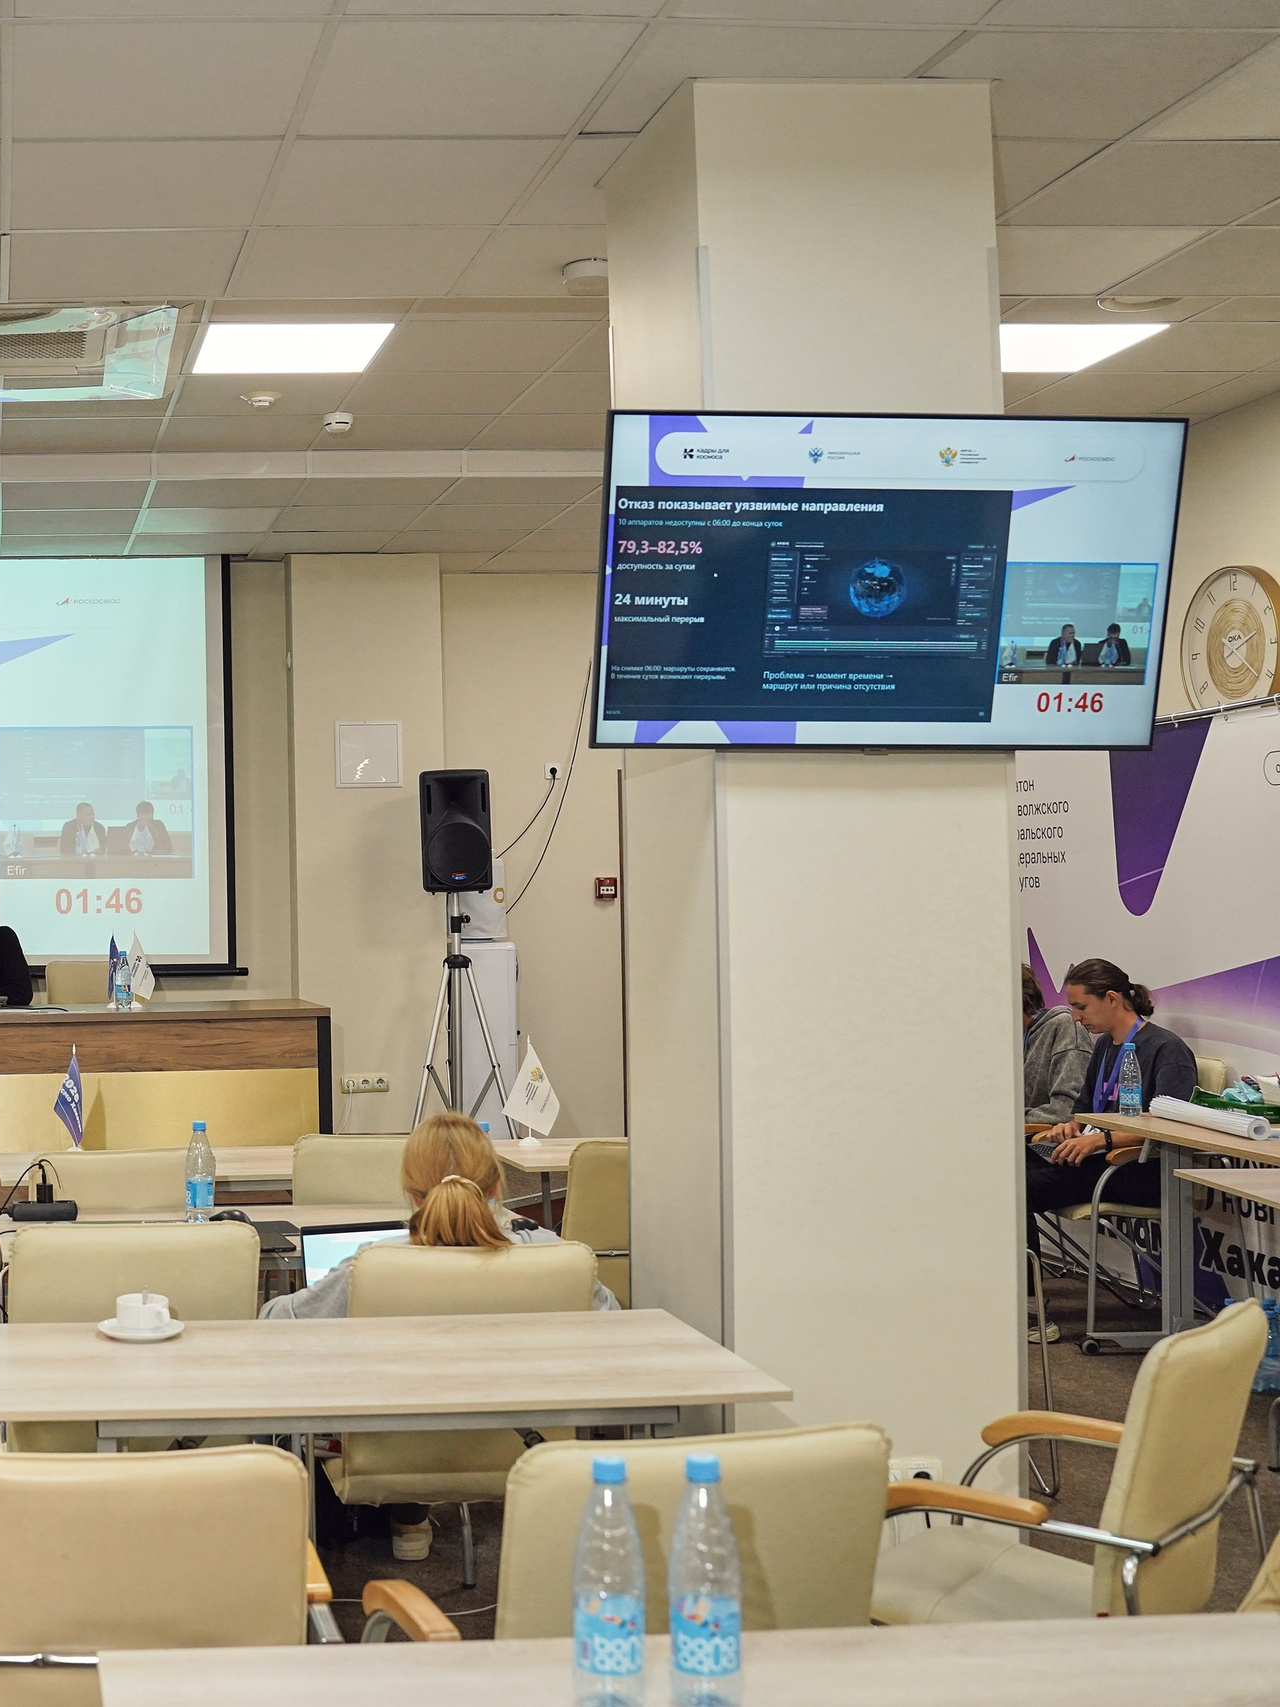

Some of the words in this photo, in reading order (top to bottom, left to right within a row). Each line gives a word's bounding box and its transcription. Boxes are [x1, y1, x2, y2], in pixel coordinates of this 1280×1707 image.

[618, 498, 654, 510] Отказ
[658, 500, 732, 510] показывает
[735, 501, 799, 513] уязвимые
[802, 501, 884, 514] направления
[617, 563, 663, 571] доступность
[1230, 574, 1237, 591] 12
[615, 594, 631, 605] 24
[635, 595, 688, 608] минуты
[614, 615, 669, 623] максимальный
[671, 616, 704, 624] перерыв
[1194, 618, 1205, 633] 10
[1228, 634, 1242, 643] ОКА
[763, 671, 804, 680] Проблема
[848, 673, 883, 681] времени
[1002, 673, 1018, 682] Efir
[762, 682, 798, 691] маршрут
[817, 683, 851, 691] причина
[854, 683, 896, 691] отсутствия
[1037, 692, 1104, 713] 01:46
[1018, 801, 1069, 816] волжского
[1018, 851, 1066, 868] еральных
[7, 865, 26, 876] Efir
[55, 887, 143, 915] 01:46
